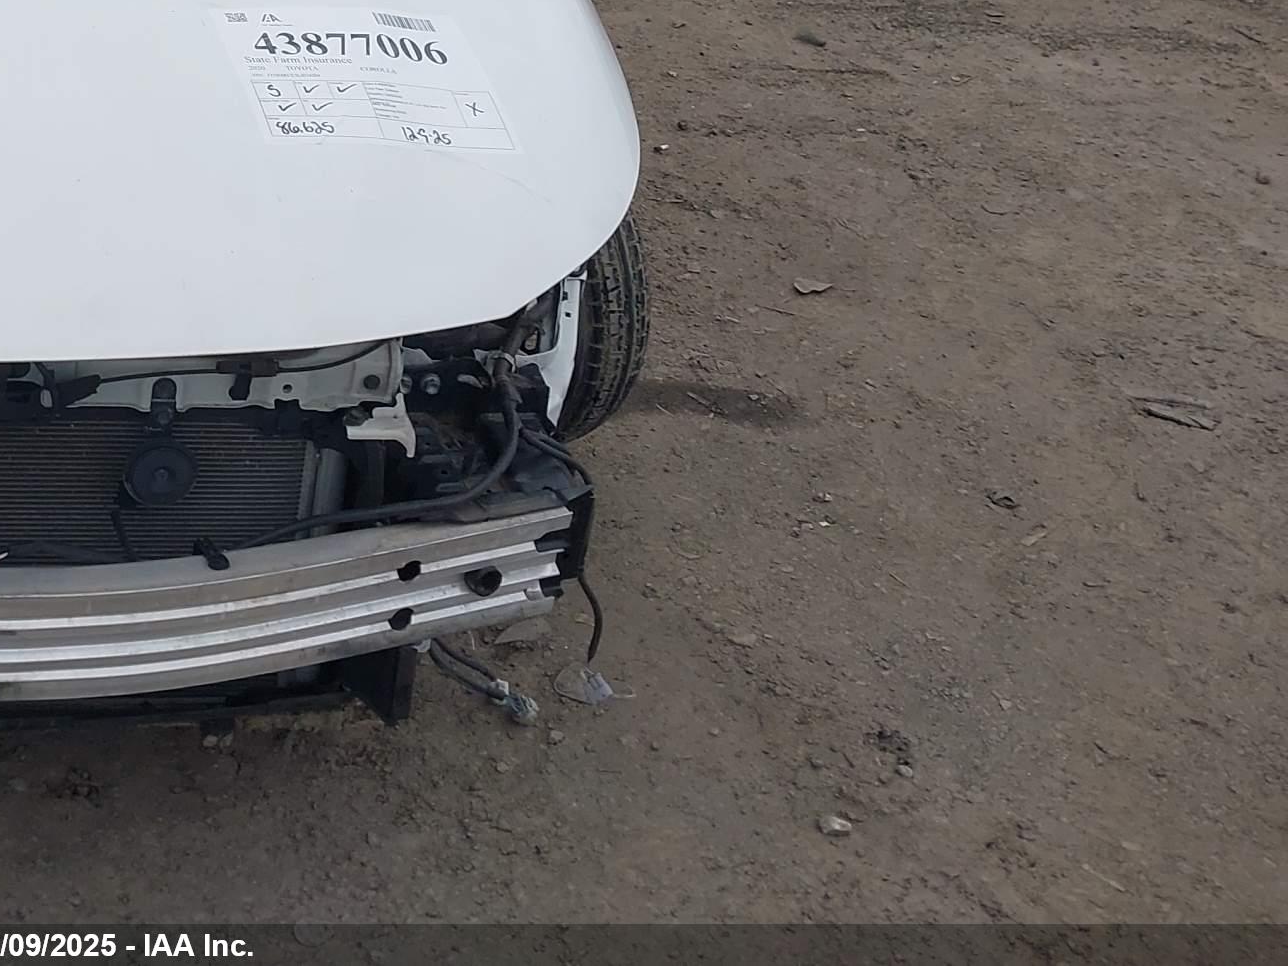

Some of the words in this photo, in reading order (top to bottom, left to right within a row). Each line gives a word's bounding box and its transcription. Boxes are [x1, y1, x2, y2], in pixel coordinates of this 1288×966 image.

[254, 32, 448, 65] 43877006
[244, 55, 271, 65] State
[273, 56, 301, 65] Farm
[302, 56, 353, 65] Insurance
